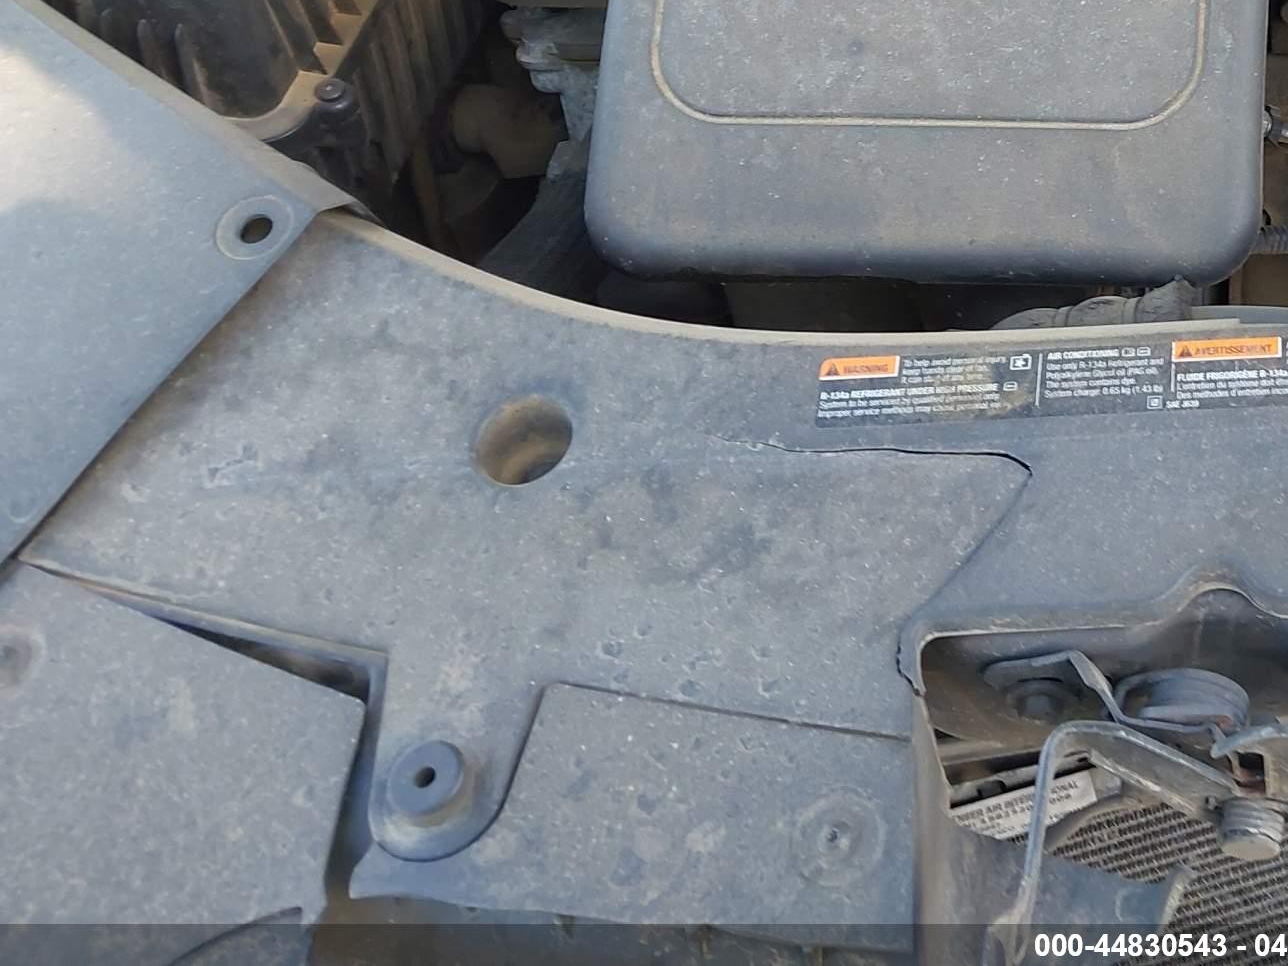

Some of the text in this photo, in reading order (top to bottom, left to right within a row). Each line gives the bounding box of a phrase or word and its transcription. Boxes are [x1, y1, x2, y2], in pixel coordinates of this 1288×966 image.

[1047, 349, 1119, 360] AIR CONDITIONING
[1195, 345, 1272, 356] AVERTISSEMENT
[914, 359, 930, 367] help
[1062, 362, 1078, 370] only
[1079, 360, 1106, 368] R-134a
[843, 364, 888, 374] WARNING
[1177, 373, 1204, 382] FLUIDE
[1260, 369, 1288, 377] R-134a
[1060, 380, 1087, 388] system
[1089, 378, 1120, 386] contains
[1217, 381, 1227, 389] du
[820, 391, 850, 399] R-134a
[850, 388, 906, 398] REFRIGERANT
[907, 386, 935, 396] UNDER
[957, 383, 999, 392] PRESSURE
[1044, 389, 1072, 398] System
[1121, 386, 1131, 395] kg
[1177, 391, 1192, 399] Des
[820, 401, 847, 409] System
[1166, 400, 1180, 409] SAE
